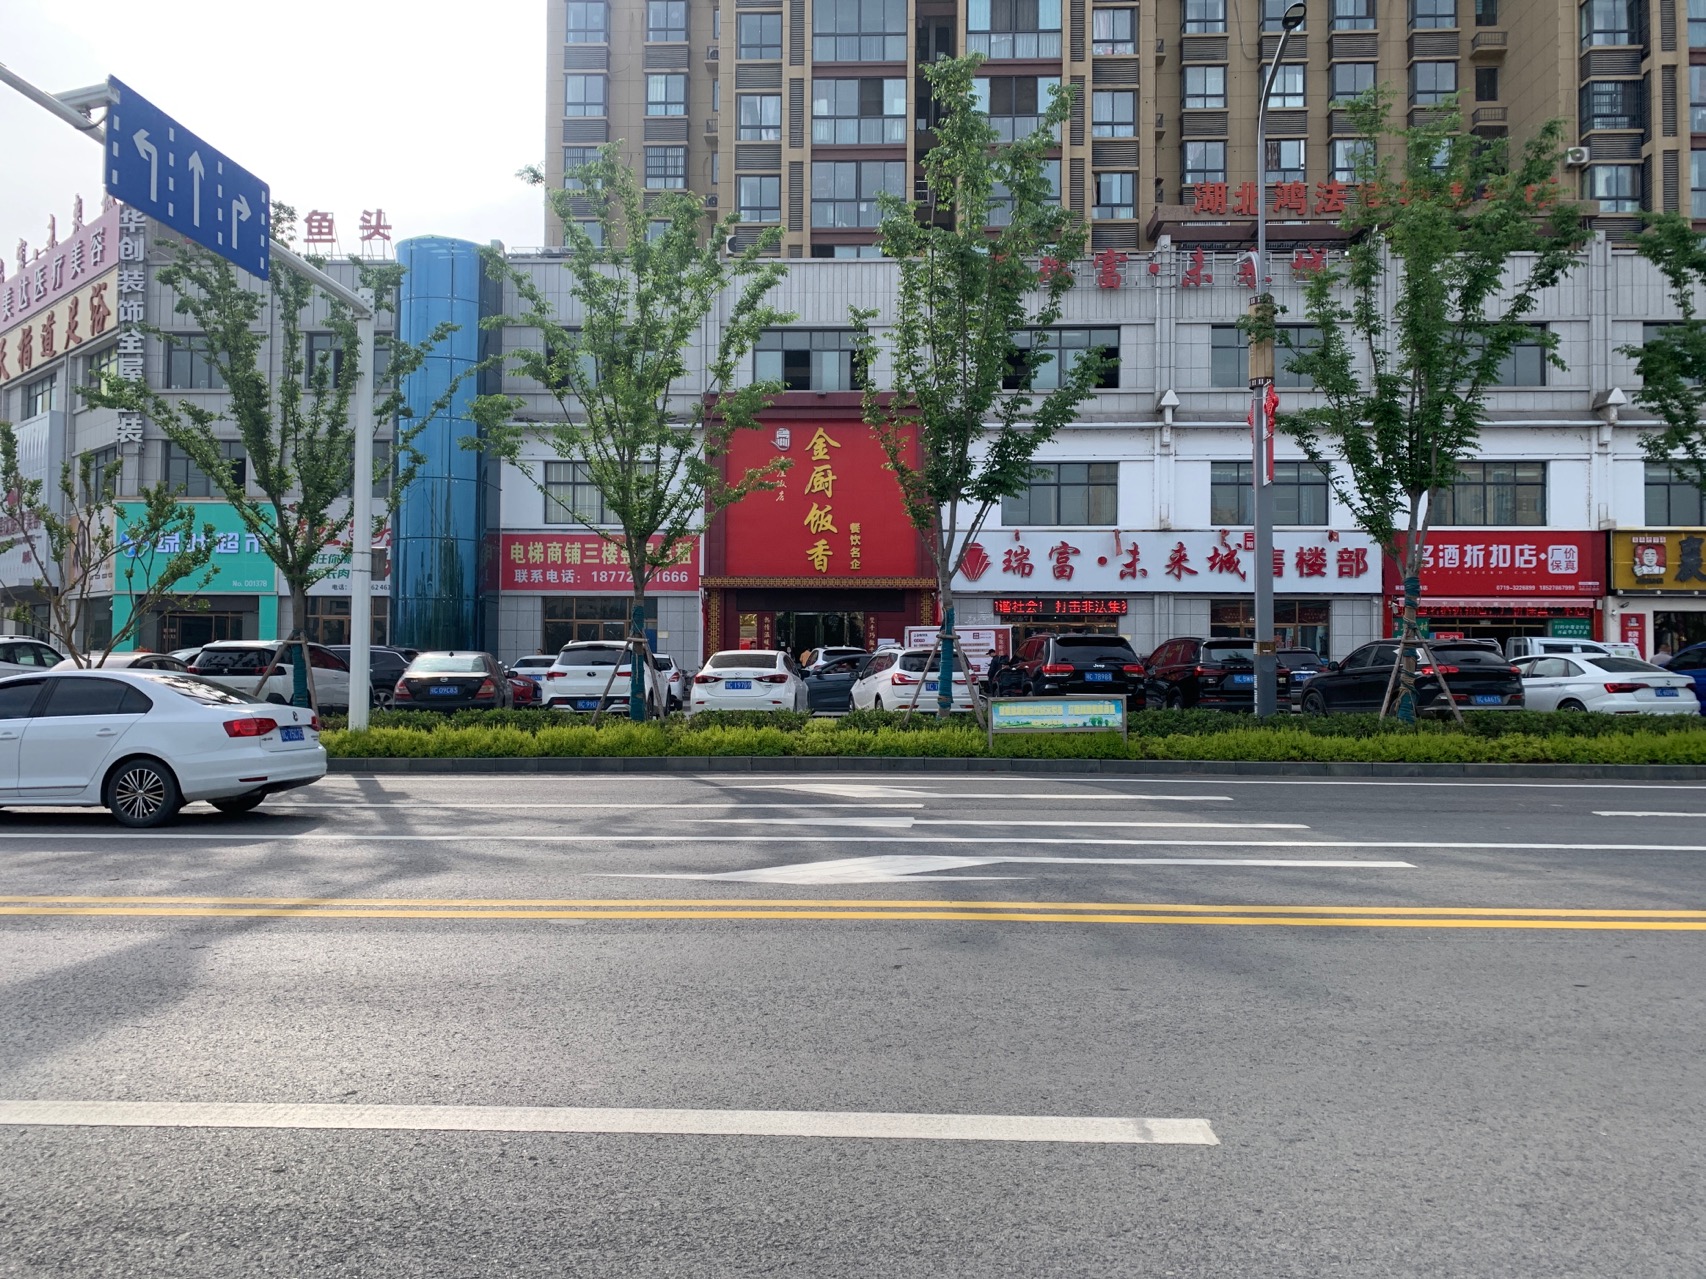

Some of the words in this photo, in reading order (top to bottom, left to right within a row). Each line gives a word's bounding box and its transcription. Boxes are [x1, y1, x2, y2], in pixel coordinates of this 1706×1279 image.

[118, 208, 146, 443] 华创装饰全屋装
[804, 427, 841, 573] 金厨饭香
